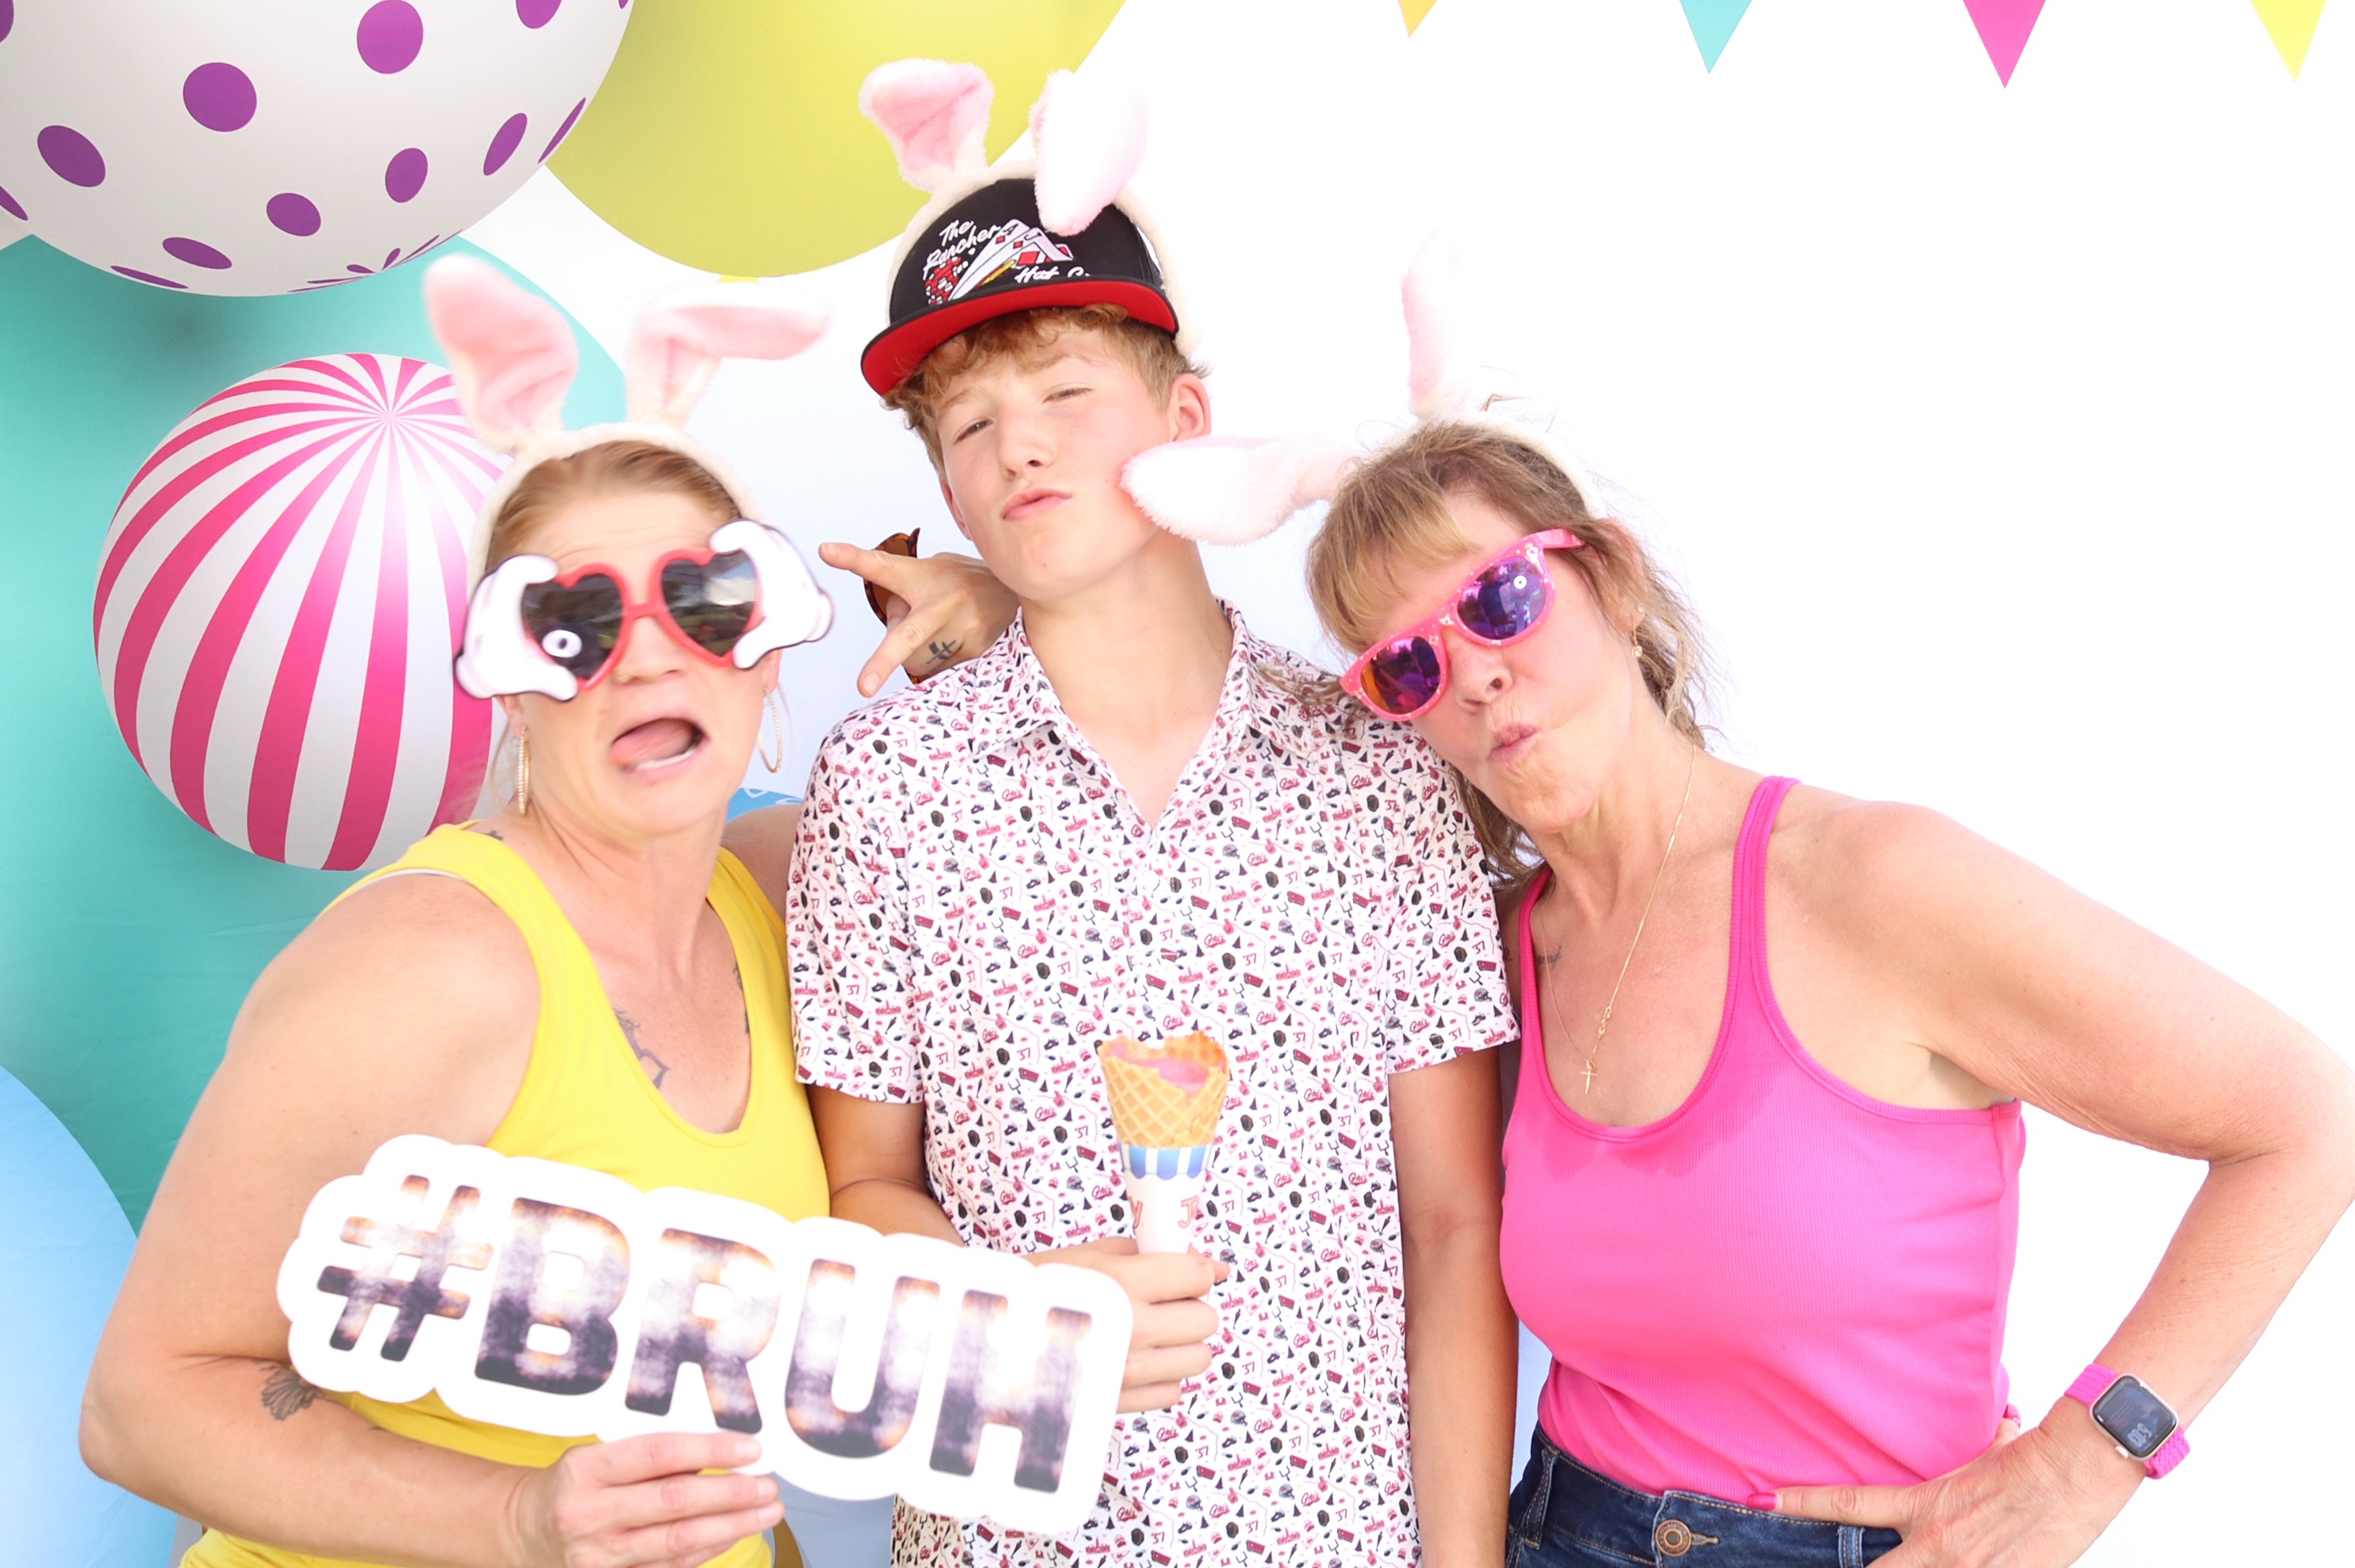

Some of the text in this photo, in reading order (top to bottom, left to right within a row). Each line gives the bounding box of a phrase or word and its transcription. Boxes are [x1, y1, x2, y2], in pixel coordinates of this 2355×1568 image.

[939, 220, 974, 246] The
[1014, 266, 1060, 283] Hat
[893, 738, 908, 748] 37
[1229, 797, 1243, 811] 37
[1385, 800, 1397, 811] 37
[1188, 877, 1202, 890] 37
[1285, 870, 1298, 884] 37
[1090, 878, 1102, 893] 37
[1427, 882, 1439, 897] 37
[999, 886, 1013, 900] 37
[912, 895, 925, 908] 37
[1159, 929, 1173, 941] 37
[1473, 940, 1485, 955] 37
[1242, 953, 1257, 966] 37
[1330, 952, 1342, 965] 37
[1057, 961, 1071, 975] 37
[966, 970, 975, 983] 37
[1392, 970, 1405, 983] 37
[847, 985, 859, 995] 37
[1293, 1032, 1306, 1042] 37
[1449, 1028, 1462, 1041] 37
[936, 1053, 948, 1065] 37
[1017, 1047, 1030, 1060] 37
[889, 1066, 902, 1077] 37
[1260, 1115, 1272, 1127] 37
[1338, 1115, 1352, 1127] 37
[985, 1131, 995, 1143] 37
[1075, 1126, 1088, 1138] 37
[1308, 1191, 1320, 1203] 37
[1222, 1200, 1234, 1213] 37
[1032, 1211, 1045, 1224] 37
[1275, 1275, 1287, 1288] 37
[317, 1175, 1093, 1494] #BRUH
[1324, 1350, 1336, 1362] 37
[1242, 1362, 1255, 1375] 37
[1369, 1425, 1381, 1437] 37
[1289, 1436, 1302, 1449] 37
[1195, 1445, 1209, 1459] 37
[1335, 1508, 1347, 1521] 37
[1246, 1520, 1258, 1533] 37
[1151, 1532, 1165, 1544] 37
